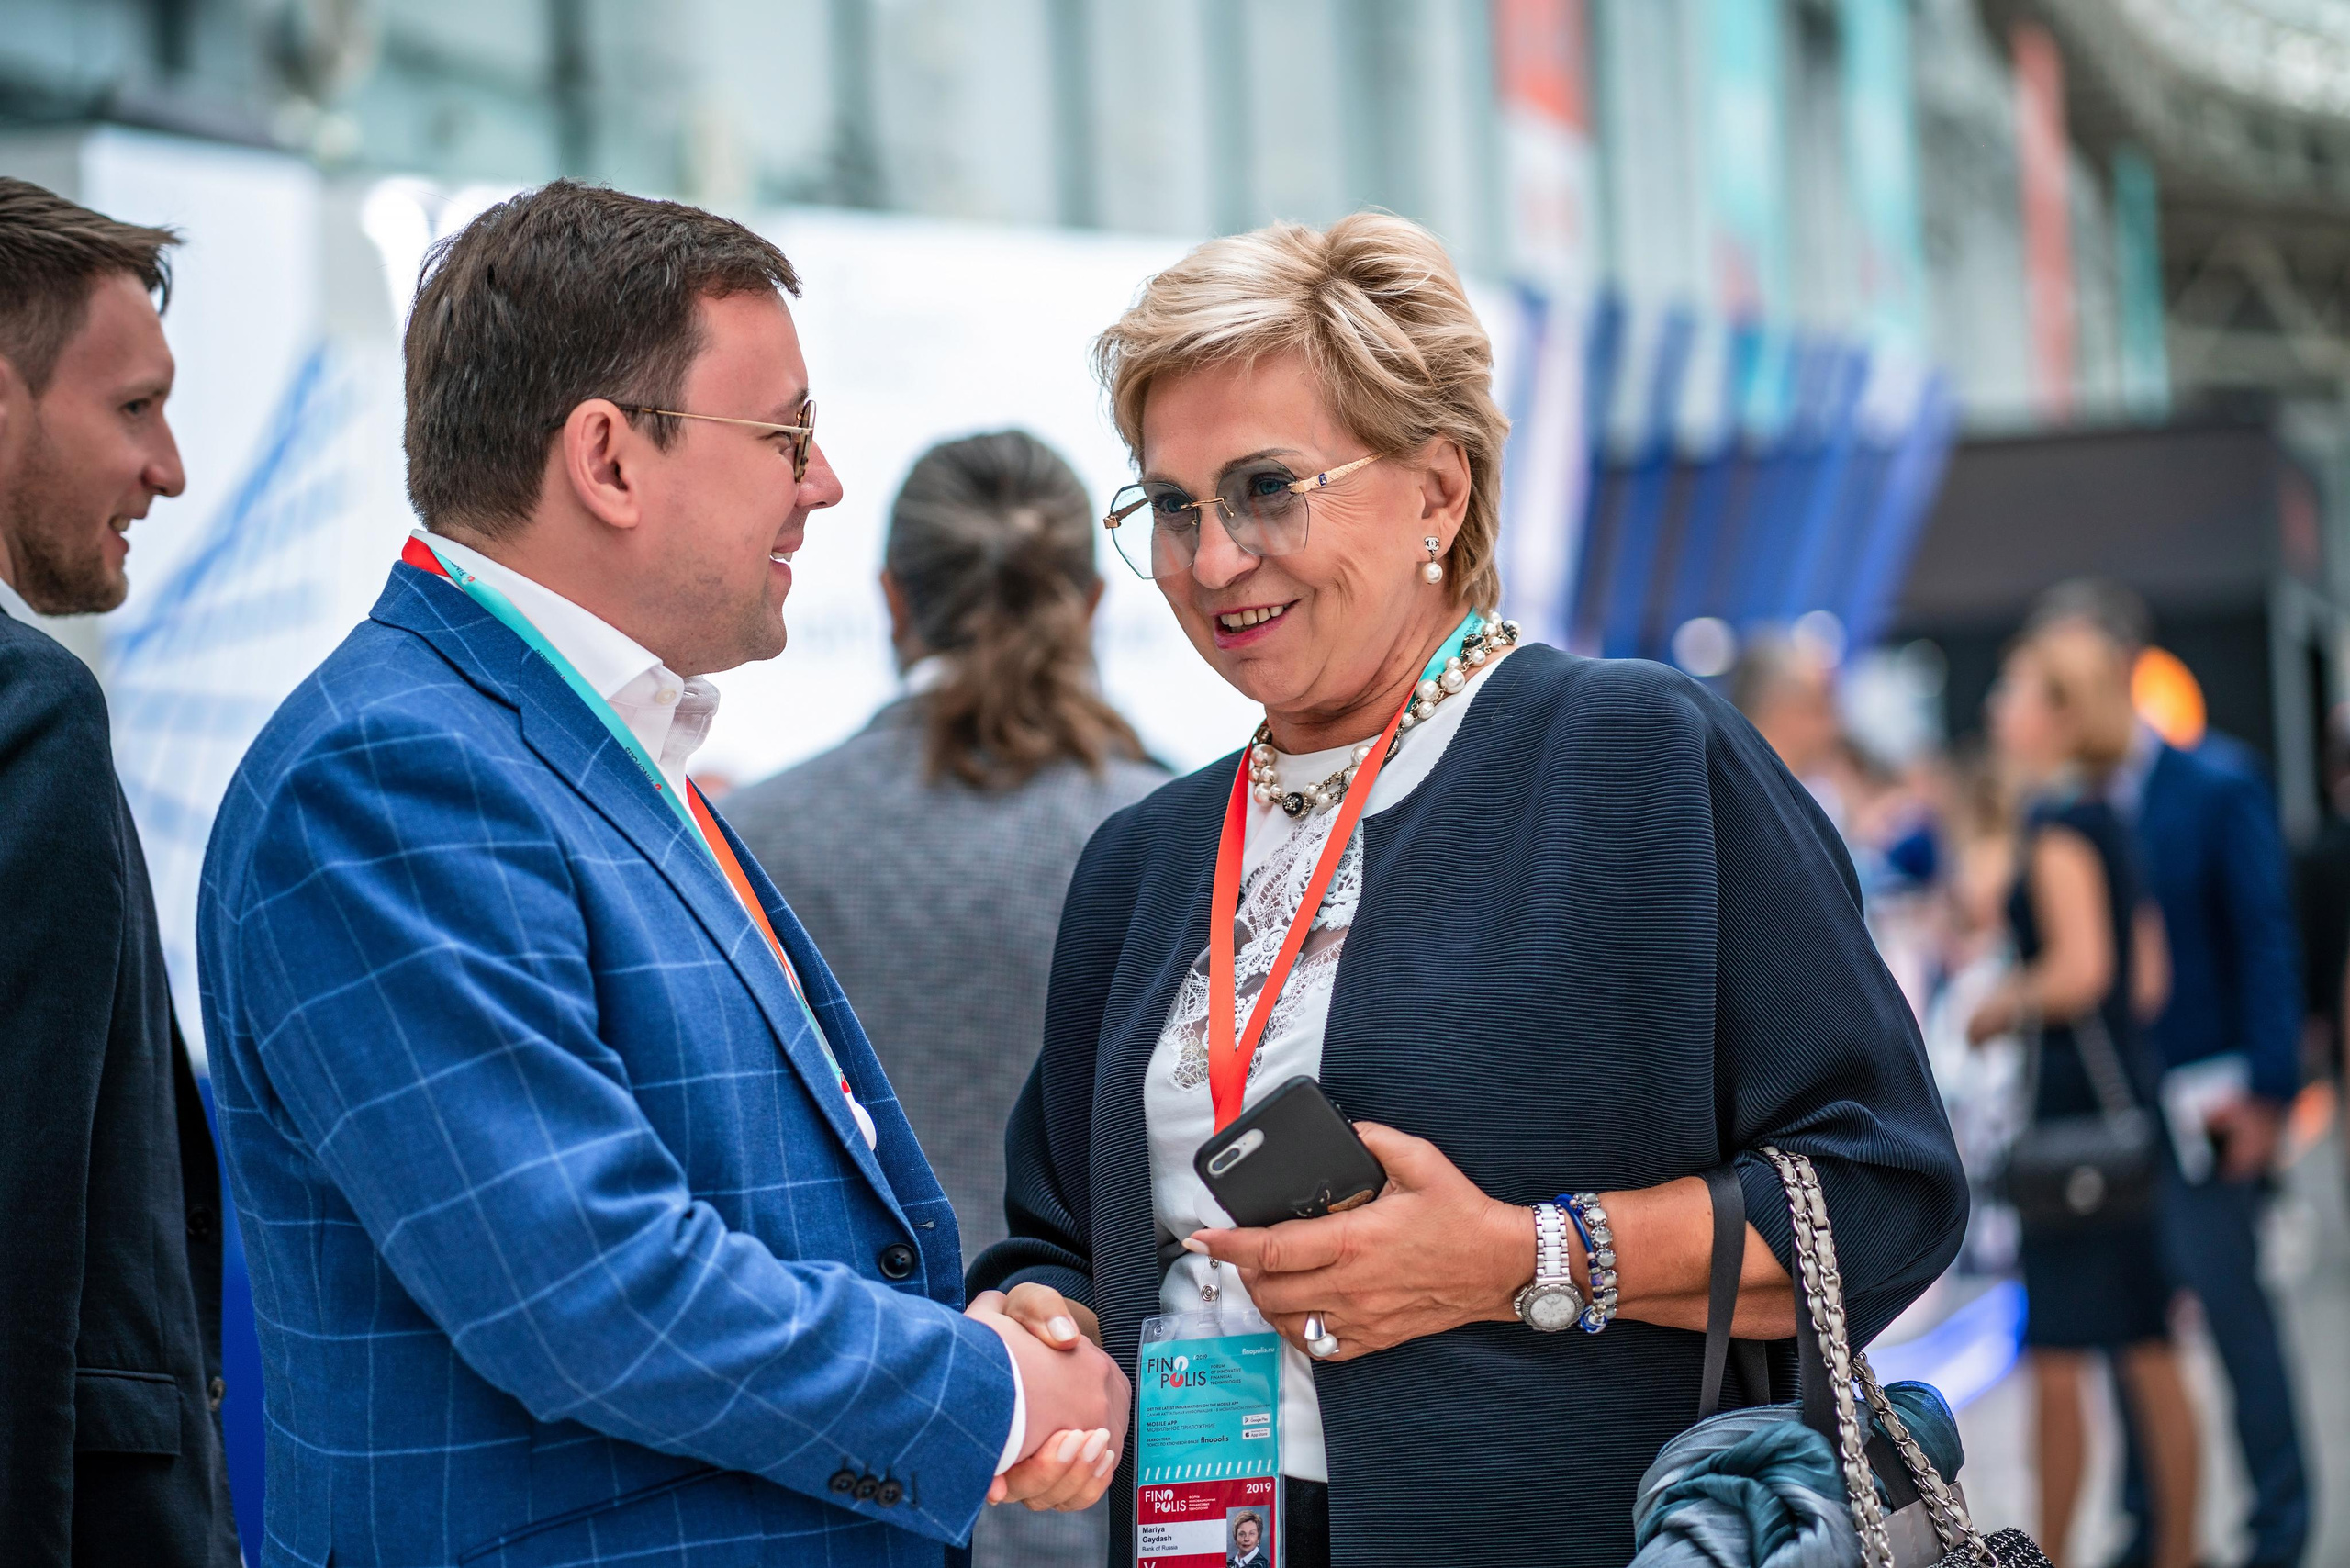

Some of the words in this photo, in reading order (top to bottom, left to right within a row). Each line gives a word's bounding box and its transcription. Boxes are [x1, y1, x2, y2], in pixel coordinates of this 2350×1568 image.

[1242, 1347, 1275, 1355] finopolis.ru
[1201, 1435, 1229, 1444] finopolis
[1246, 1483, 1272, 1494] 2019
[1142, 1535, 1172, 1544] Gaydash
